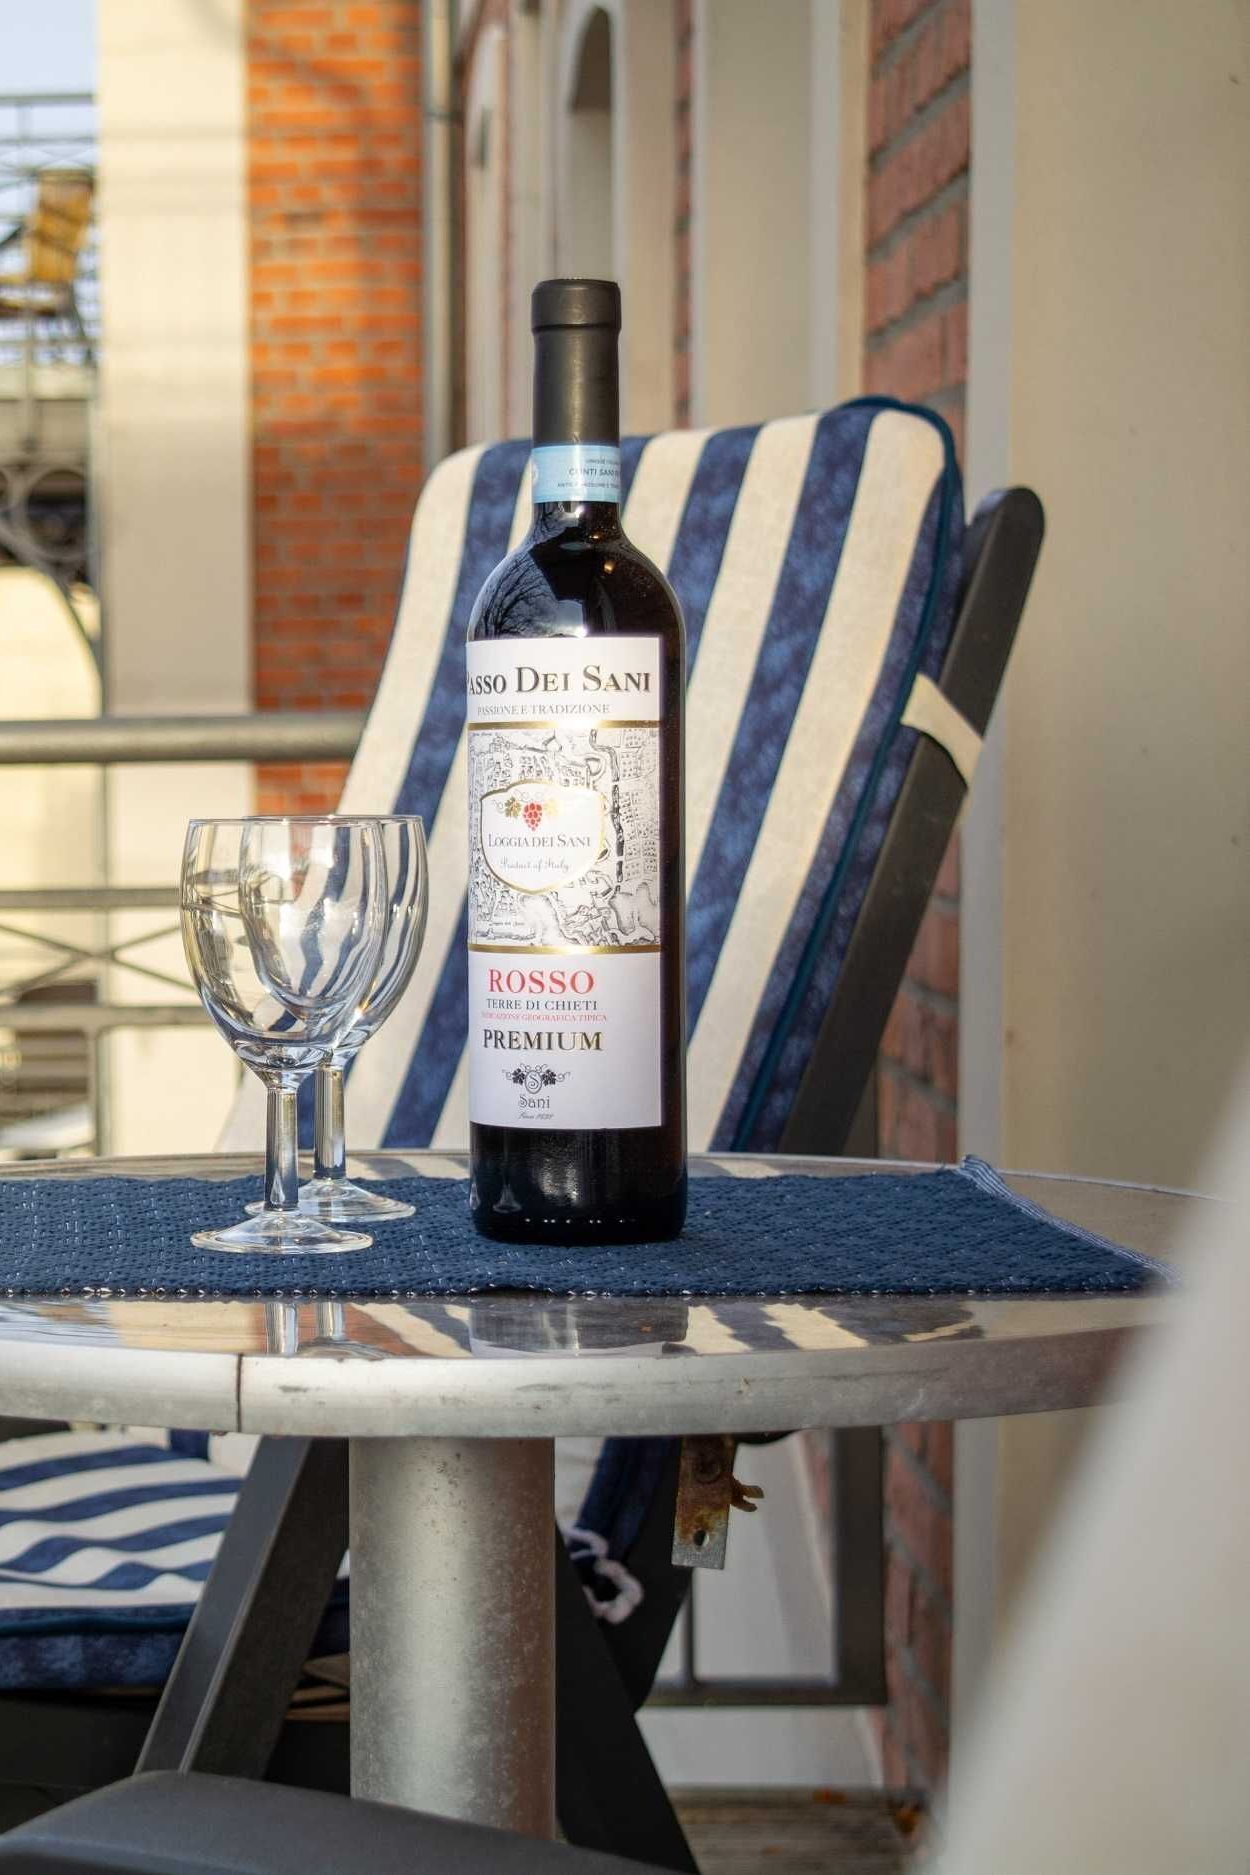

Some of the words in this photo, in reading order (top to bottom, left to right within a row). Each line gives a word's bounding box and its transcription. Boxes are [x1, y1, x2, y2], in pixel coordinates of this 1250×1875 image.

[516, 665, 570, 693] DEI
[582, 664, 651, 694] SANI
[477, 704, 520, 716] PASSIONE
[521, 704, 528, 715] E
[530, 703, 611, 715] TRADIZIONE
[488, 833, 529, 848] LOGGIA
[557, 833, 591, 848] SANI
[488, 969, 595, 995] ROSSO
[486, 998, 522, 1010] TERRE
[526, 1000, 540, 1010] DI
[544, 1000, 598, 1011] CHIETI
[521, 1013, 576, 1022] GEOGRAFICA
[578, 1013, 607, 1022] TIPICA
[483, 1028, 603, 1051] PREMIUM
[518, 1094, 550, 1109] Sani
